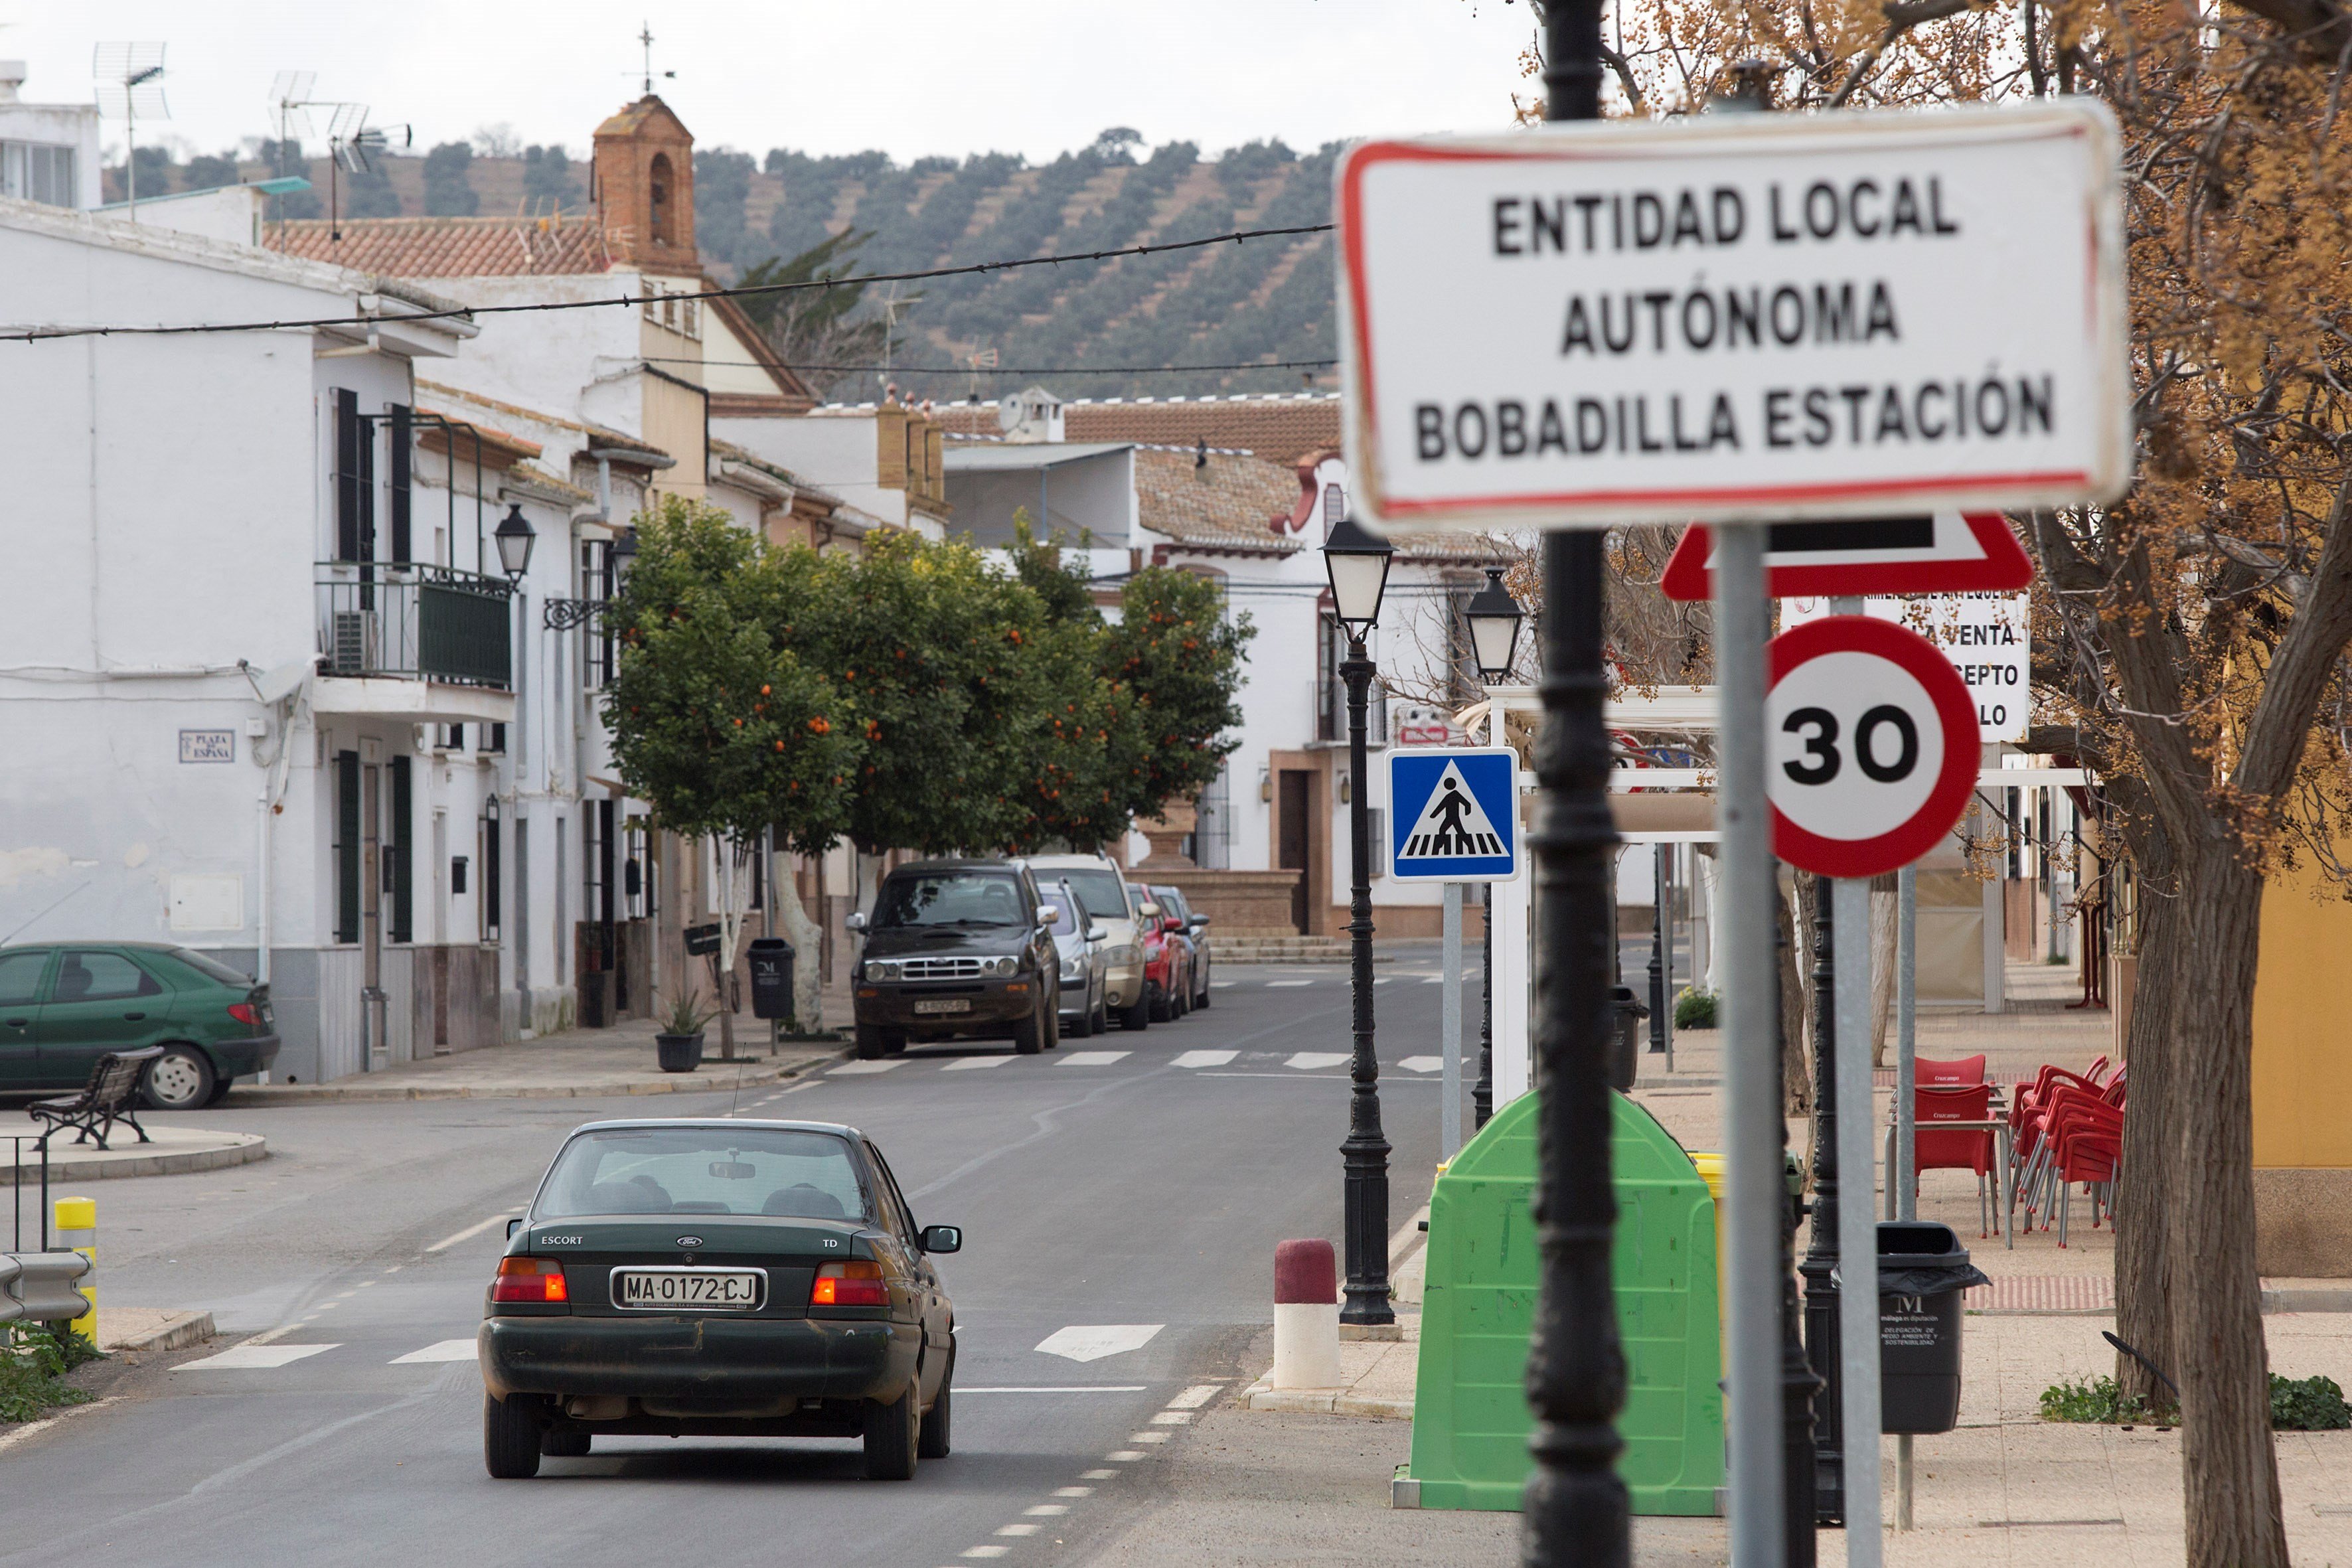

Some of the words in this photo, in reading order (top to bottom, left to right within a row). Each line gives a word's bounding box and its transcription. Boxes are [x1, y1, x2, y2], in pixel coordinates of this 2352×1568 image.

[1491, 186, 1747, 257] ENTIDAD
[1768, 176, 1960, 242] LOCAL
[1560, 271, 1901, 358] AUTÓNOMA
[1415, 391, 1741, 463] BOBADILLA
[1763, 360, 2056, 451] ESTACIÓN
[195, 748, 228, 757] ESPAÑA
[196, 735, 226, 744] PLAZA
[1782, 704, 1919, 787] 30
[541, 1236, 583, 1245] ESCORT
[1896, 1296, 1924, 1313] M
